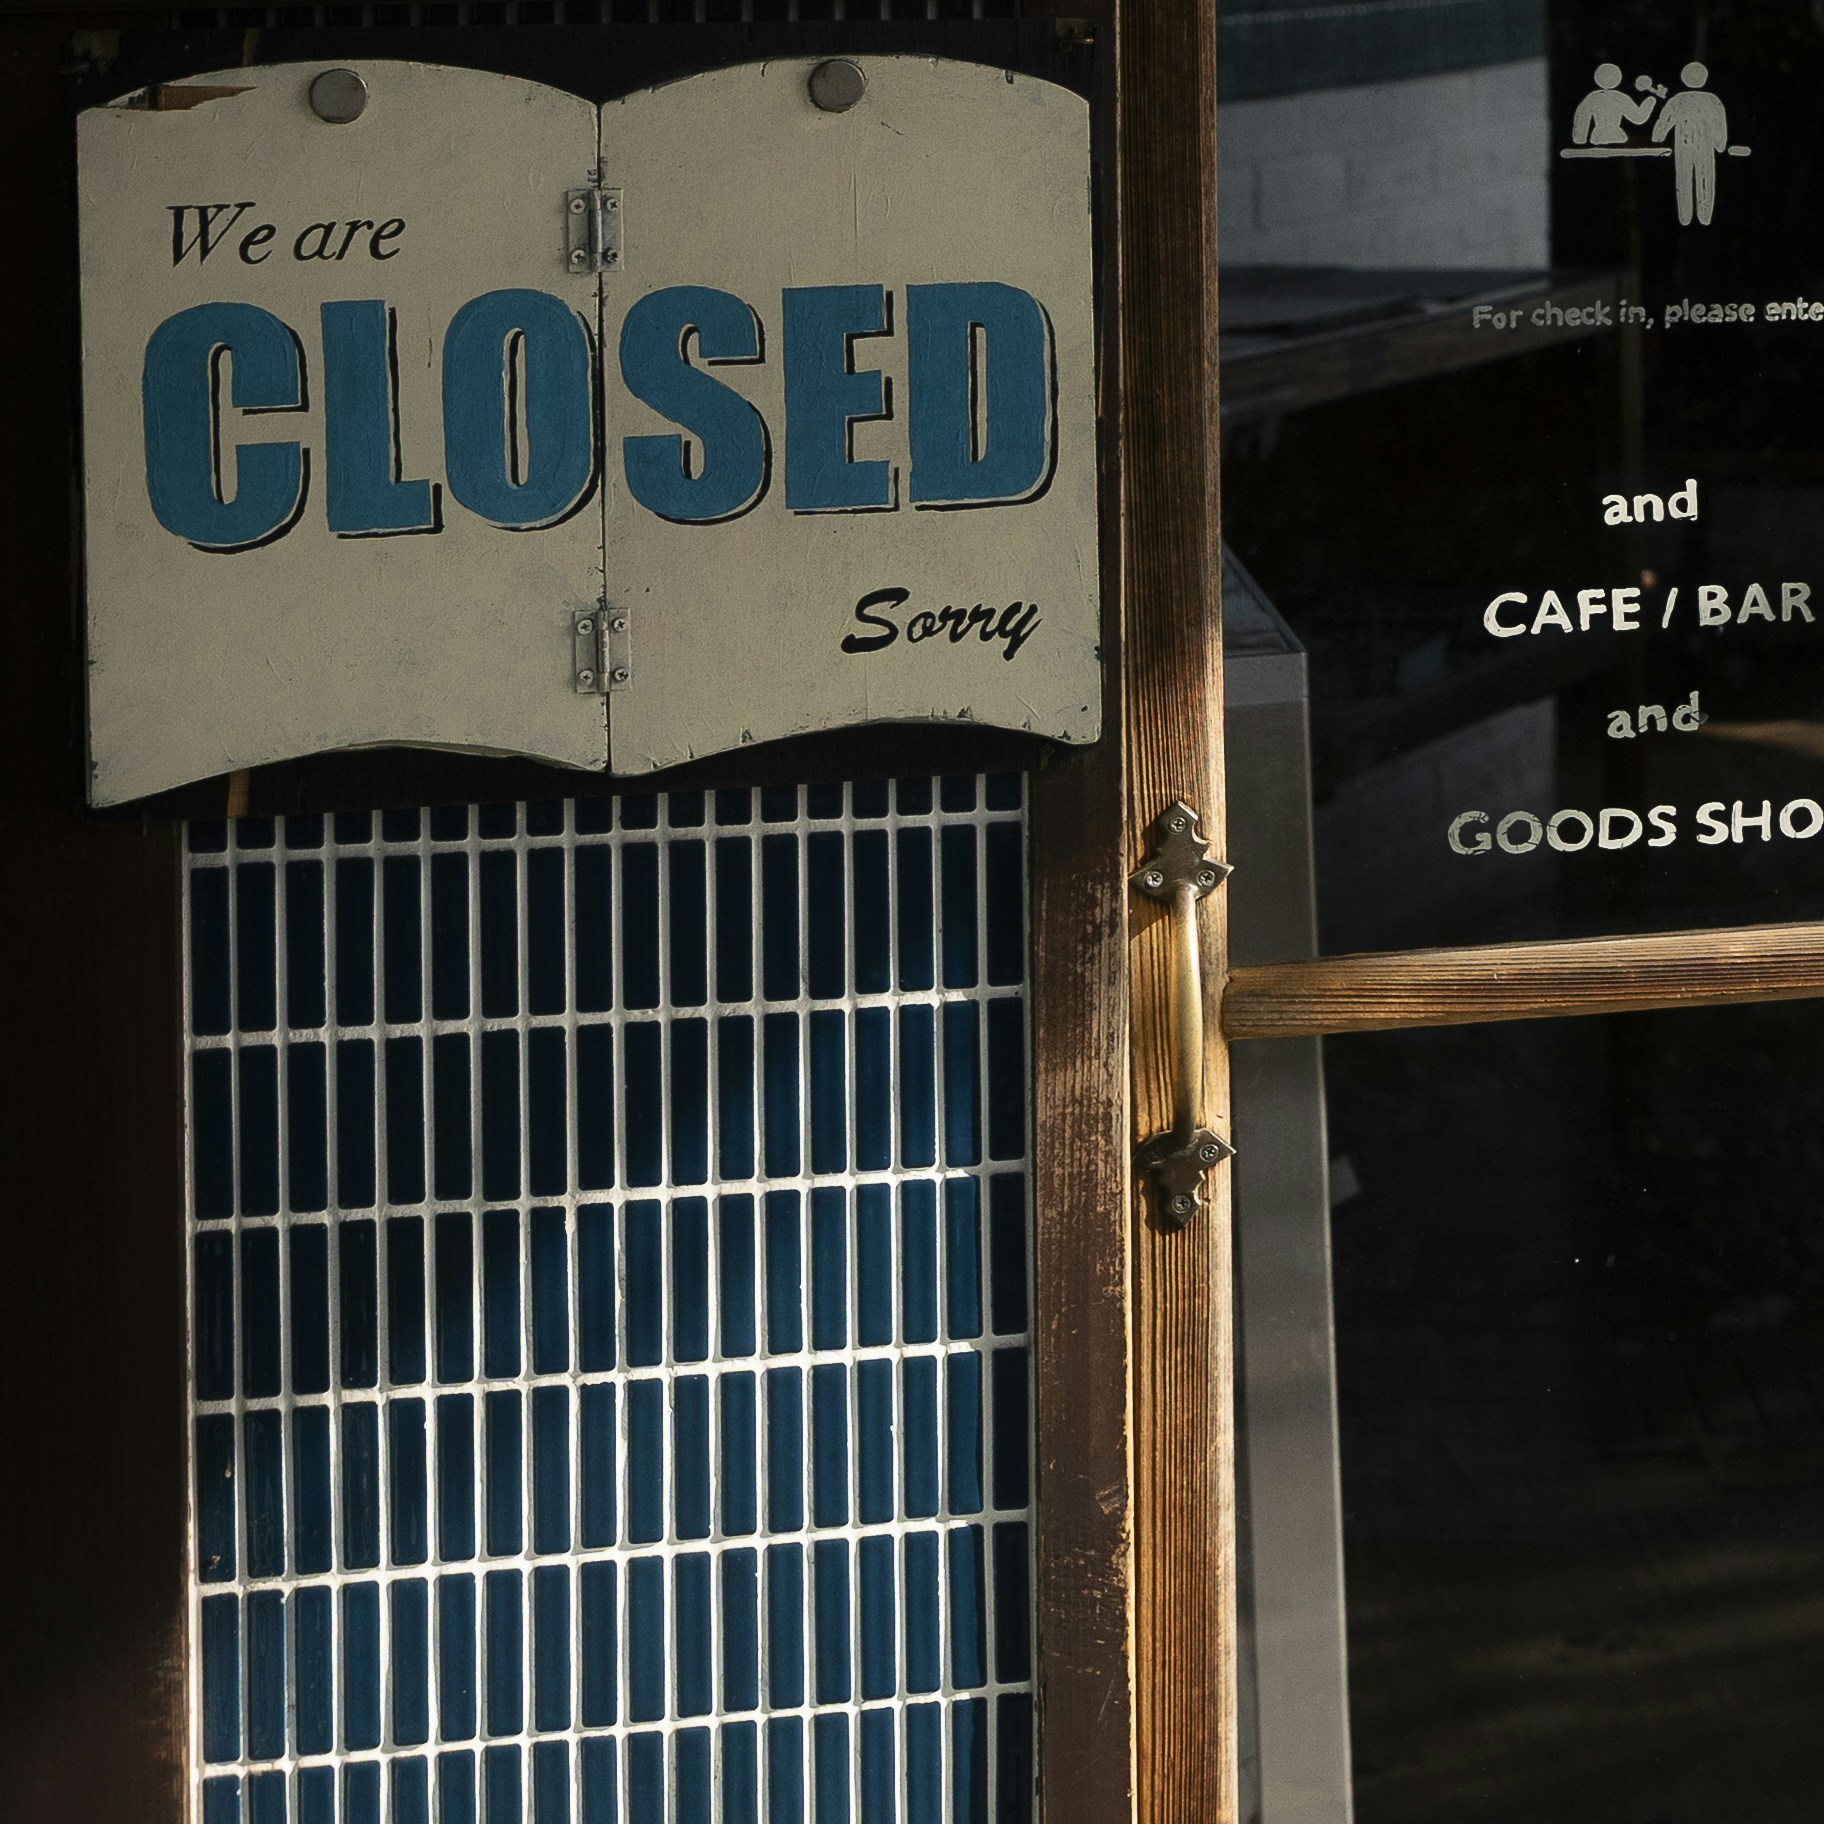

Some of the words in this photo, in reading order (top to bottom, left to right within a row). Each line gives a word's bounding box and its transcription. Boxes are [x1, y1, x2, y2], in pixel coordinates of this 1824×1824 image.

[166, 201, 276, 268] We
[293, 212, 406, 262] are
[1473, 304, 1523, 330] For
[1531, 300, 1611, 326] check
[1619, 299, 1653, 330] in,
[1664, 297, 1755, 329] please
[142, 281, 1059, 555] CLOSED
[1602, 479, 1699, 525] and
[841, 587, 1041, 660] Sorry
[1483, 588, 1641, 638] CAFE
[1660, 587, 1680, 629] /
[1698, 582, 1816, 628] BAR
[1606, 691, 1709, 740] and
[1447, 805, 1677, 856] GOODS
